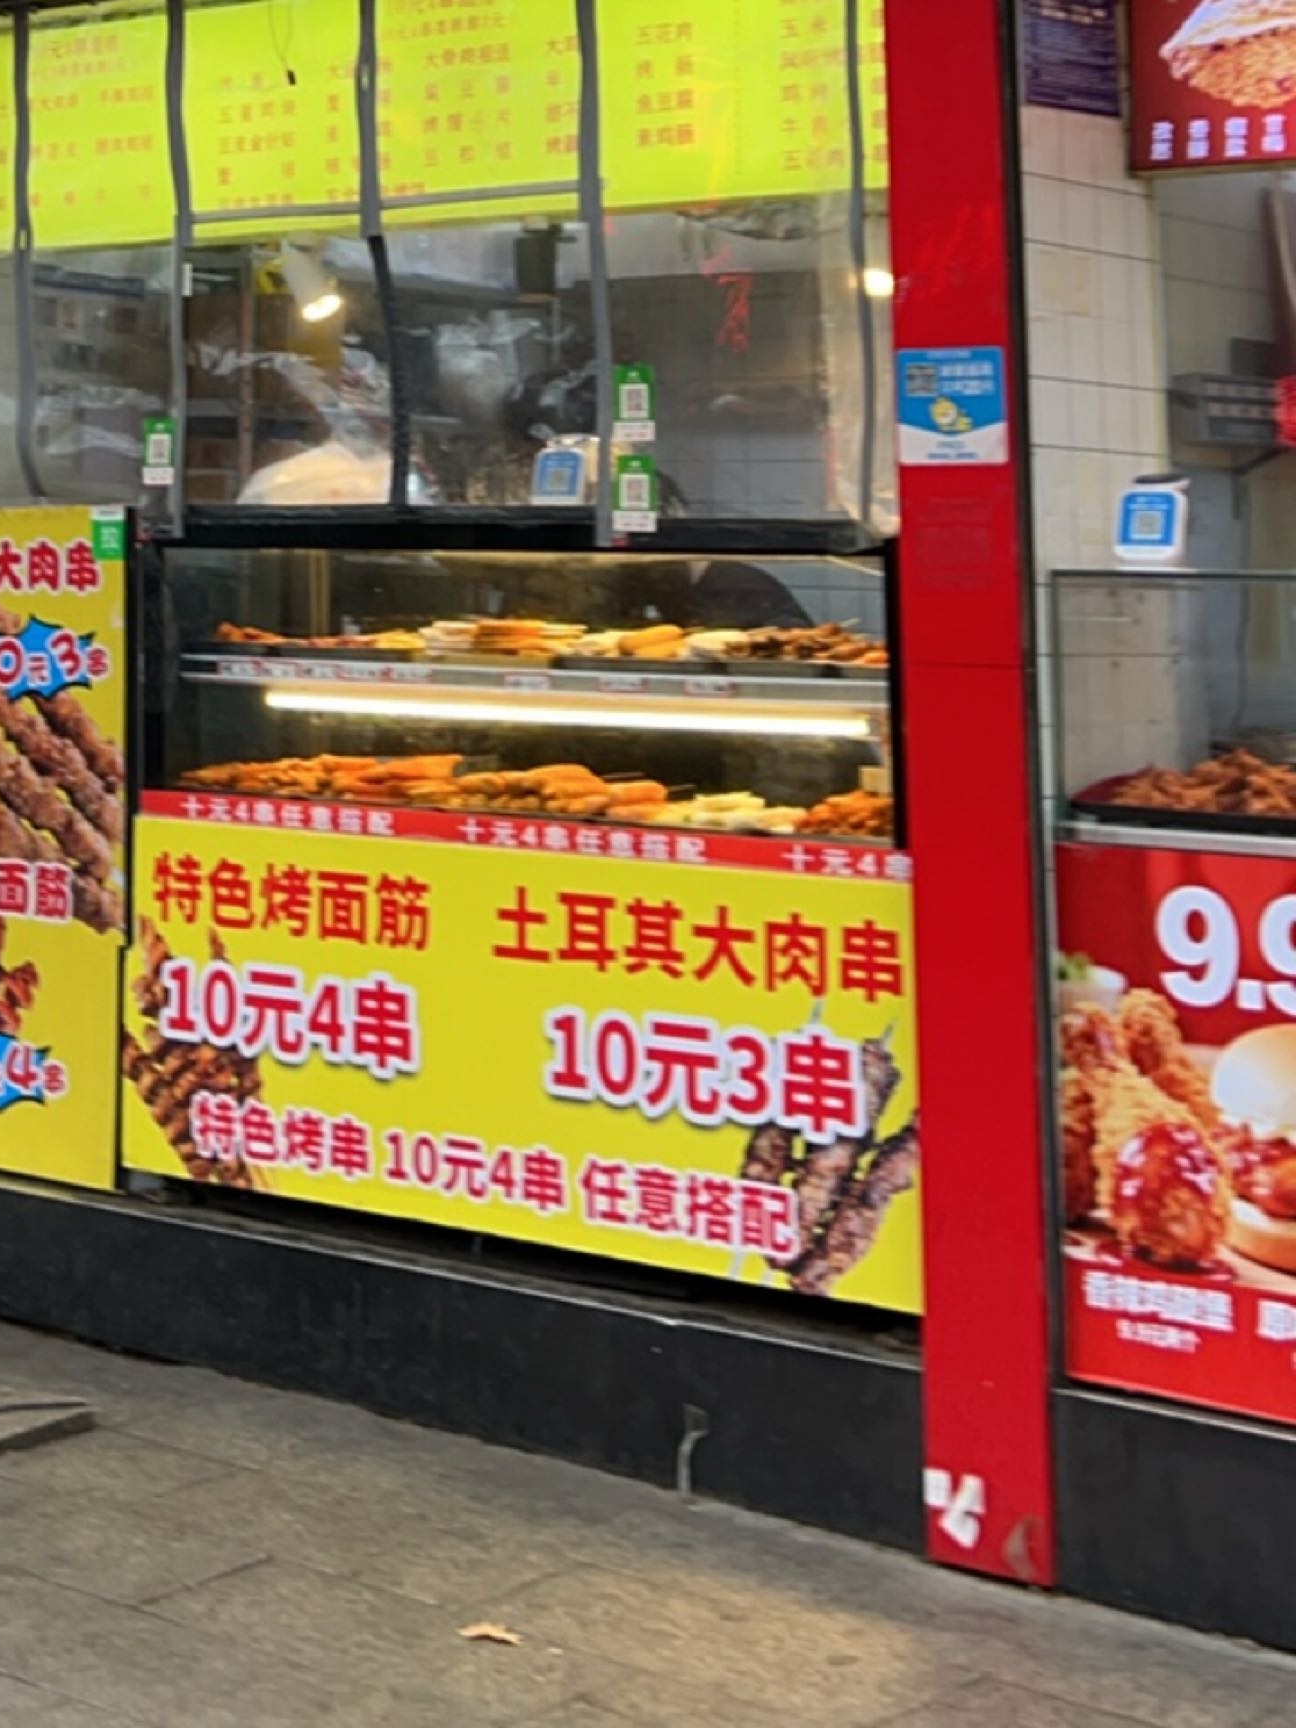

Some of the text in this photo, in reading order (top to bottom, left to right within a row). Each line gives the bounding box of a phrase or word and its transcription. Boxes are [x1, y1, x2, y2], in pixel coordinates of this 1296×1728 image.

[180, 797, 396, 837] 十元4串任意搭配
[458, 817, 707, 864] 十元4串任意搭配
[153, 851, 431, 952] 特色烤面筋
[492, 885, 904, 1002] 土耳其大肉串
[161, 958, 420, 1080] 10元4串
[547, 1006, 866, 1142] 10元3串
[191, 1093, 802, 1258] 特色烤串 10元4串 任意搭配
